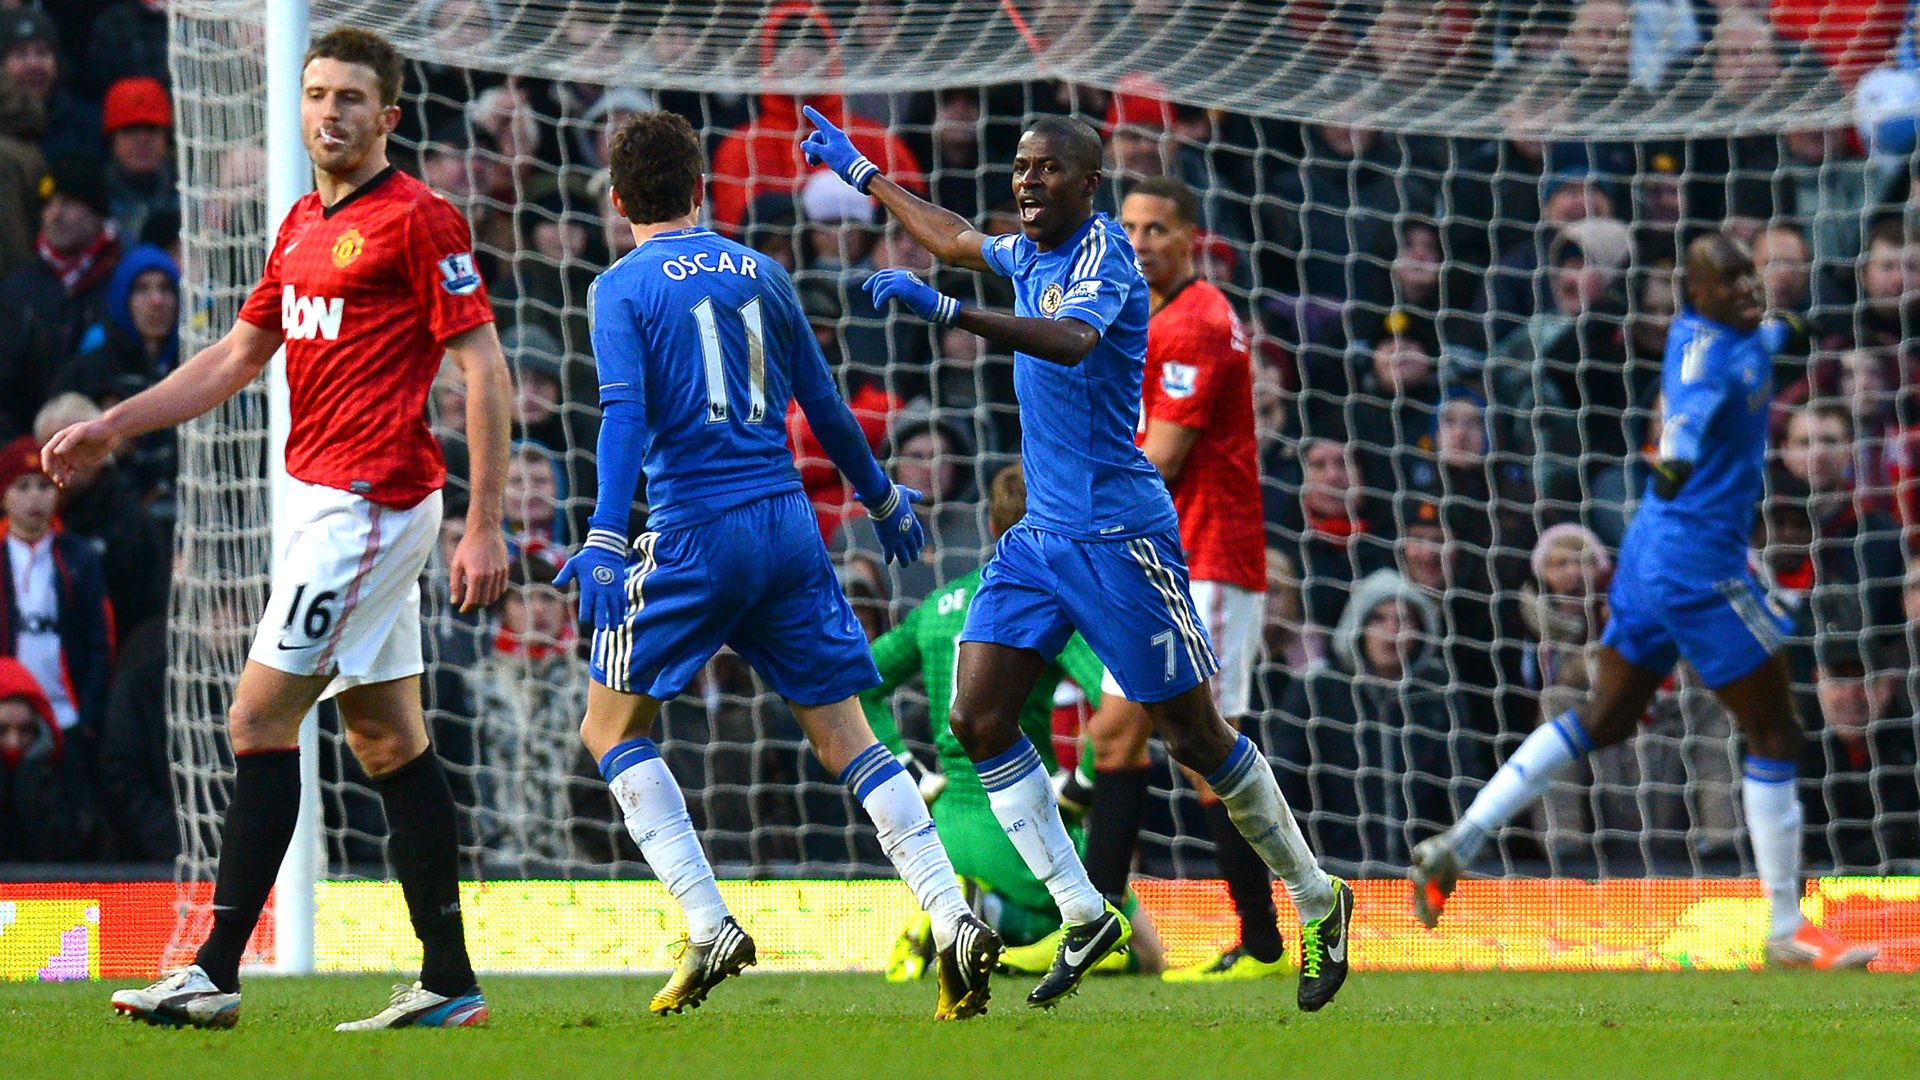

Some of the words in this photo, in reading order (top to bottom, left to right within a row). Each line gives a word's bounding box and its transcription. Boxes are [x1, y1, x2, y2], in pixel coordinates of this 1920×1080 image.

[662, 252, 757, 281] OSCAR
[281, 284, 344, 340] AON
[690, 295, 766, 424] 11
[284, 584, 338, 640] 16
[1151, 628, 1176, 683] 7
